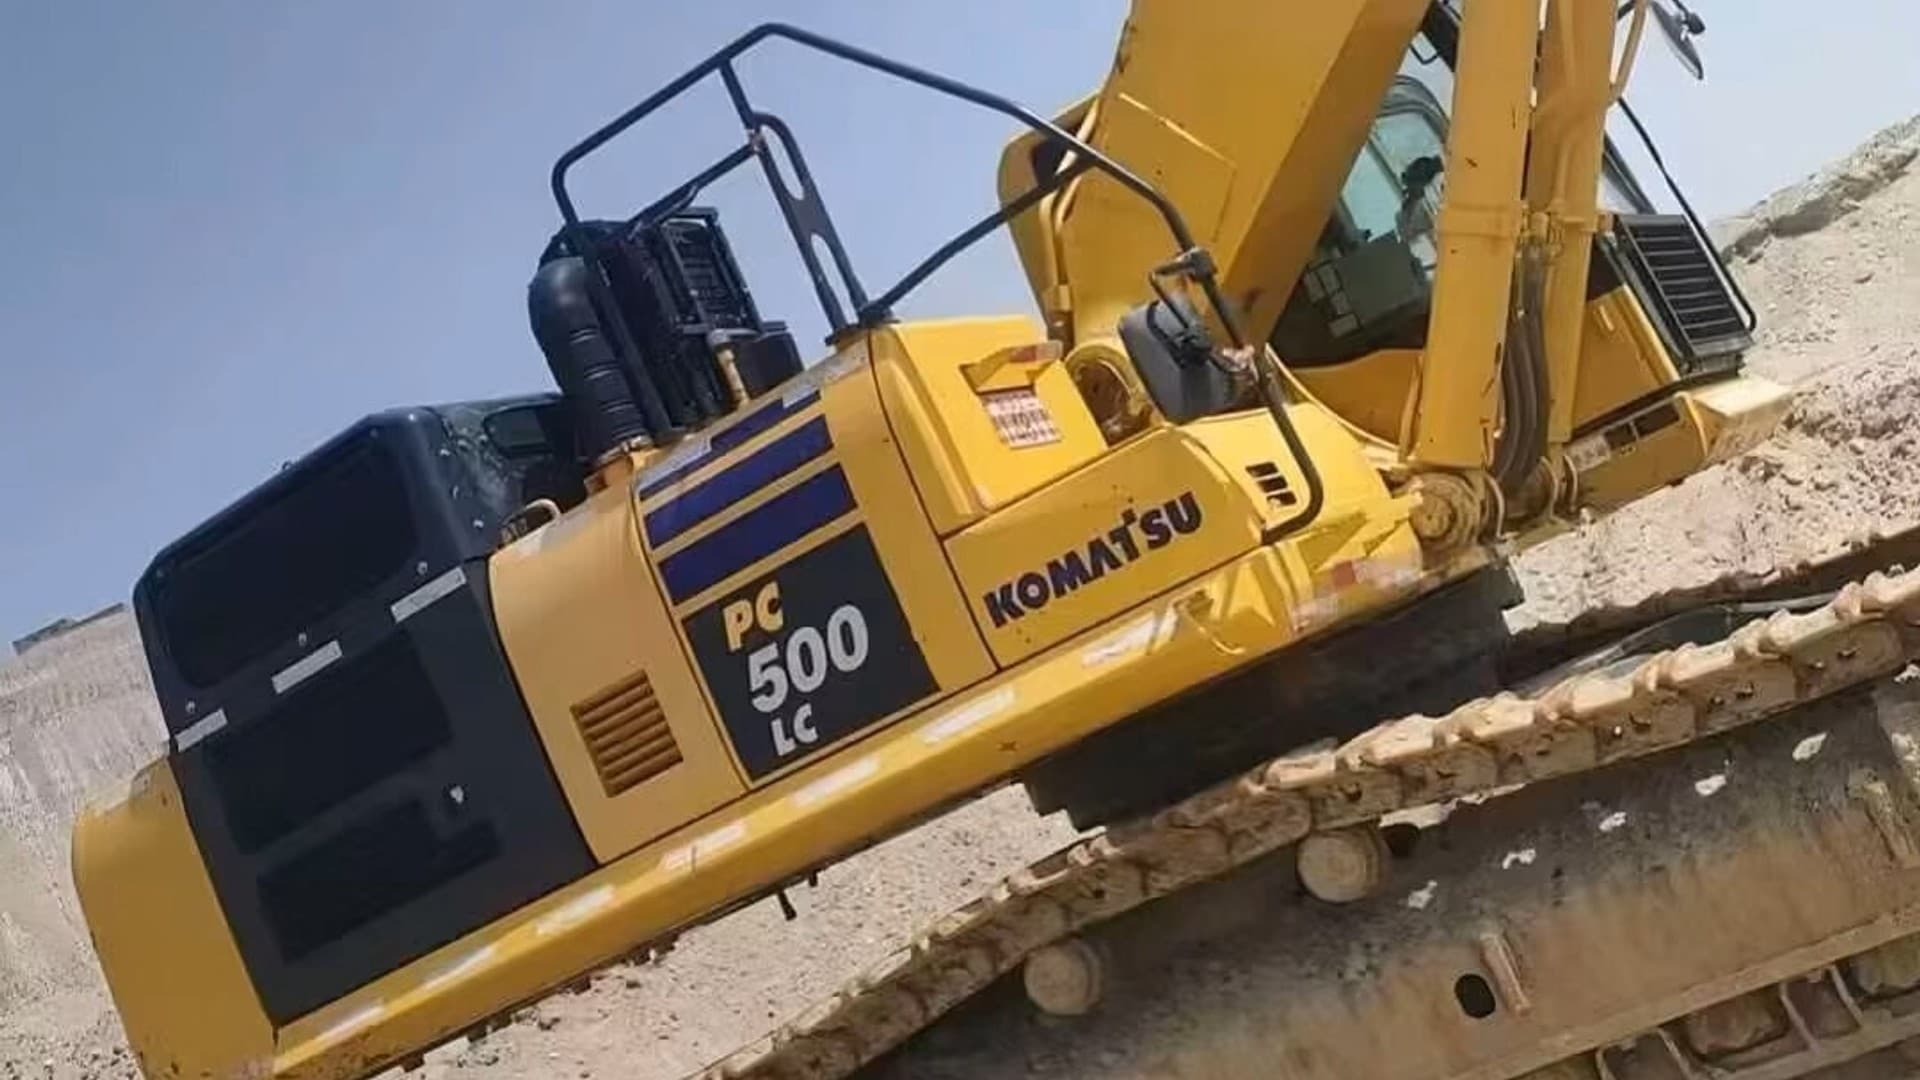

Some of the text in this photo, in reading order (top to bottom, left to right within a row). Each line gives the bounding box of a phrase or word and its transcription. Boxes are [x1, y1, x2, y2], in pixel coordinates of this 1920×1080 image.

[982, 491, 1203, 628] KOMATSU
[723, 580, 784, 651] PC
[748, 604, 869, 713] 500
[771, 703, 819, 757] LC
